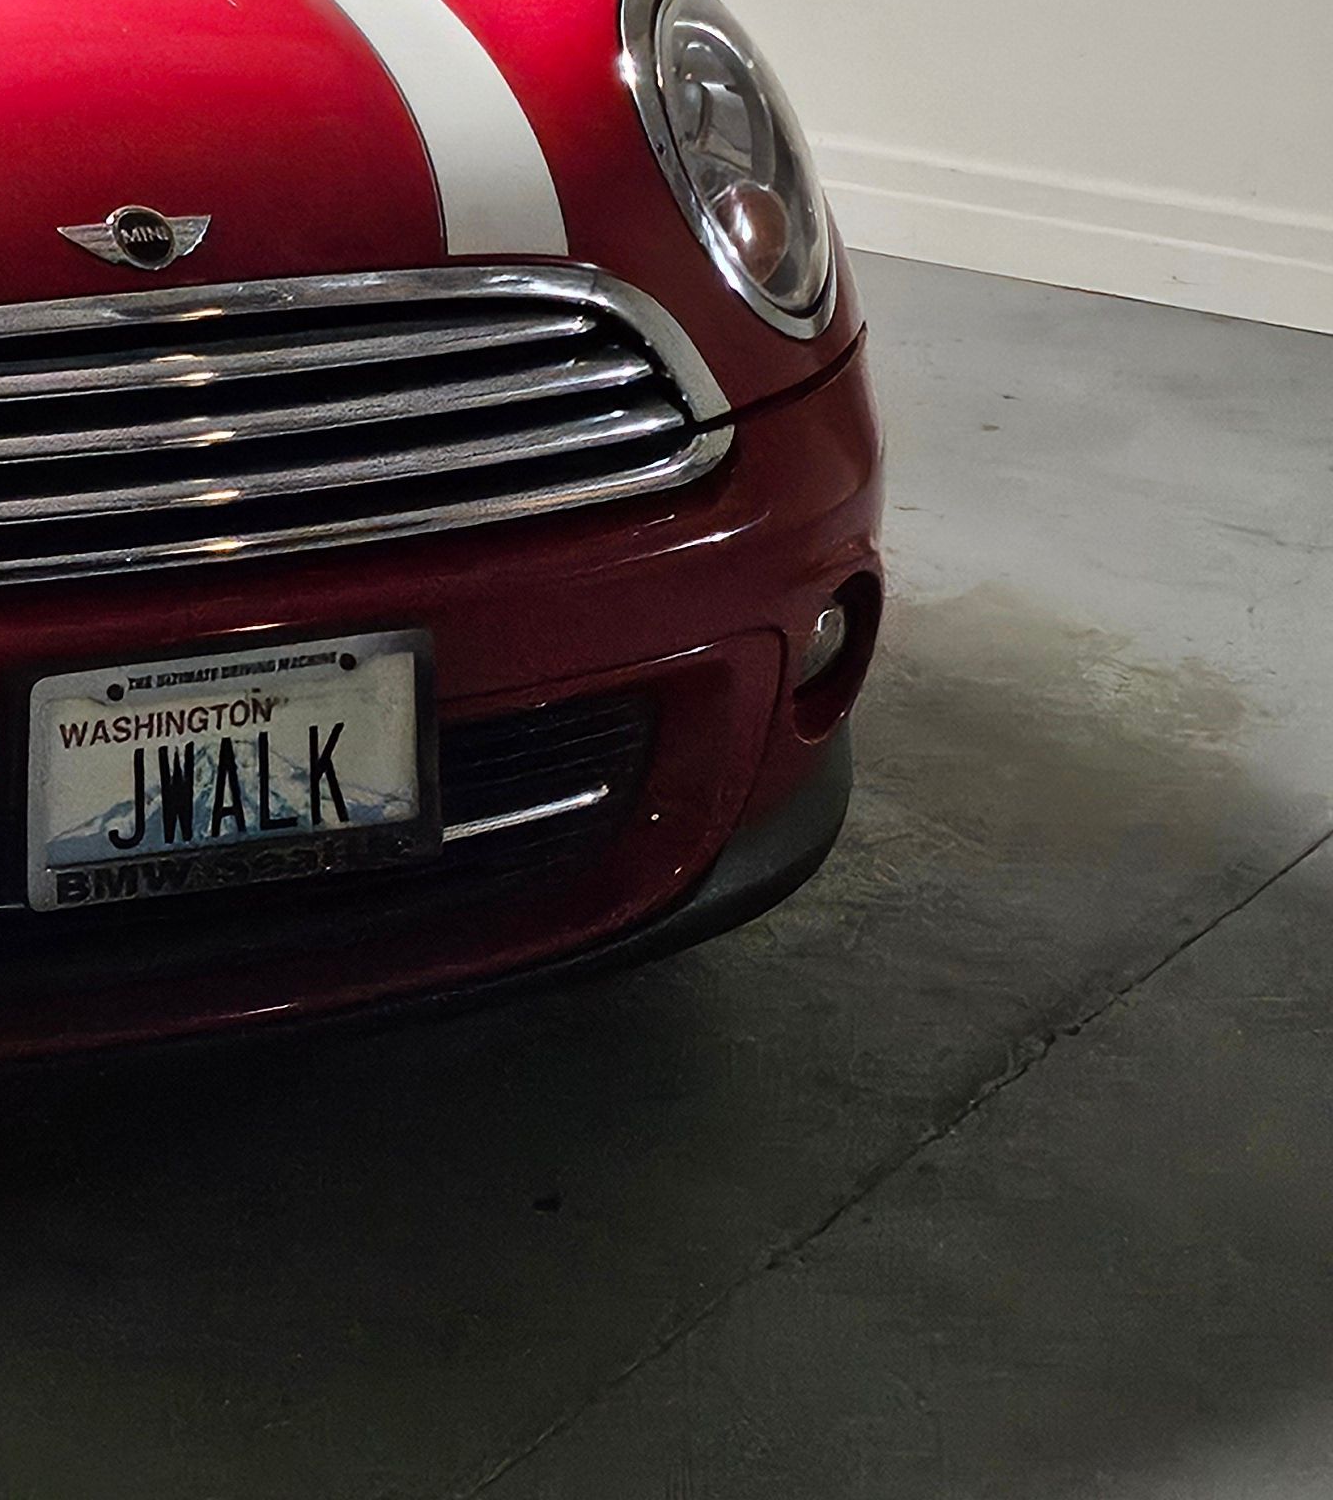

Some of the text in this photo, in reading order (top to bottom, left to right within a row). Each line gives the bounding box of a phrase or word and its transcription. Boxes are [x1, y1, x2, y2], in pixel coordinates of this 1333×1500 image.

[120, 226, 169, 244] MINI
[60, 697, 273, 749] WASHINGTON
[108, 722, 350, 850] JWALK
[55, 863, 192, 905] BMW
